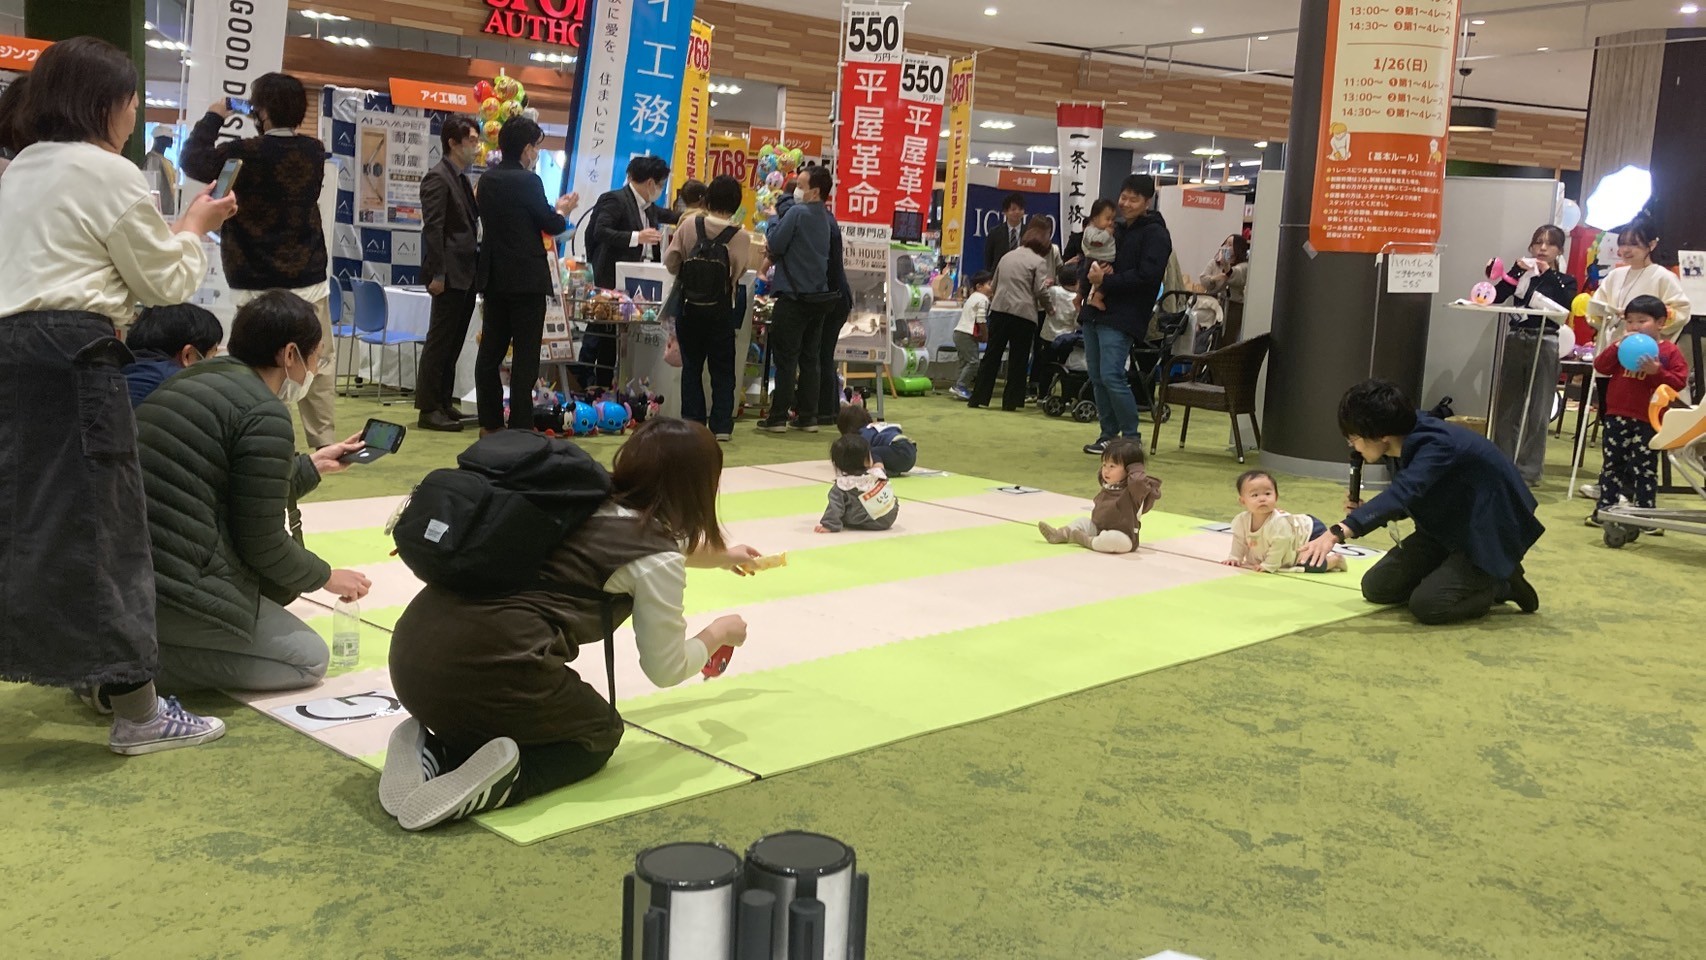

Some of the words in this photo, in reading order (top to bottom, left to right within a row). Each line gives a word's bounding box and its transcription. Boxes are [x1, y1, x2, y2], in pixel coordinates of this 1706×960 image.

[225, 0, 254, 71] GOOD
[848, 15, 899, 52] 550
[687, 35, 709, 71] 768
[1373, 57, 1428, 72] 1/26(日)
[588, 0, 621, 183] に愛を、住まいにアイを
[902, 64, 944, 93] 550
[215, 80, 247, 142] DSI
[420, 90, 468, 105] アイ工務店
[847, 68, 888, 217] 平屋革命
[708, 149, 746, 182] 768
[859, 248, 886, 260] HOUSE
[1402, 279, 1422, 288] こちら
